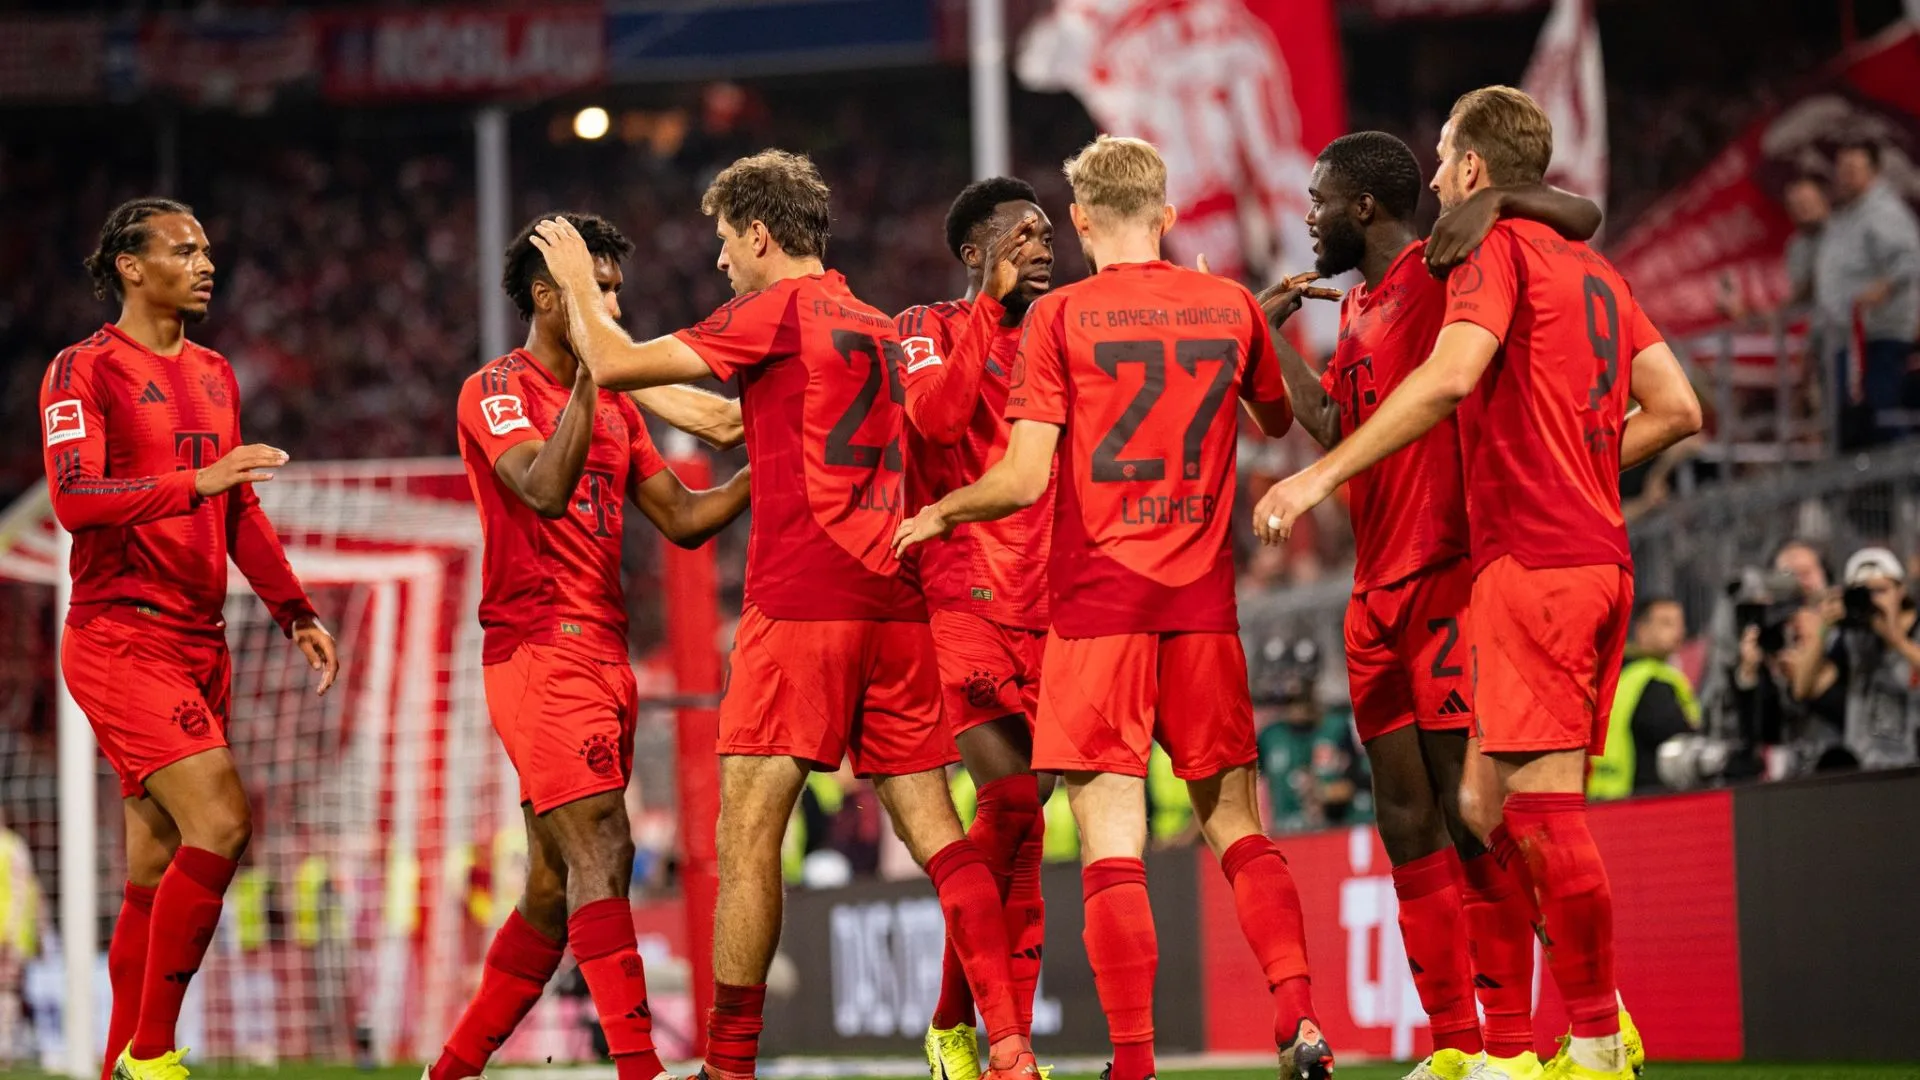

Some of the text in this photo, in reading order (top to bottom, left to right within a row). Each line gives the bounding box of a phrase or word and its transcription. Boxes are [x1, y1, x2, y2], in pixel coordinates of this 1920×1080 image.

[1080, 311, 1100, 328] FC
[1107, 310, 1169, 328] BAYERN
[1583, 274, 1619, 411] 9
[1091, 338, 1239, 483] 27
[1121, 494, 1214, 527] LAIMER
[1427, 617, 1464, 679] 2
